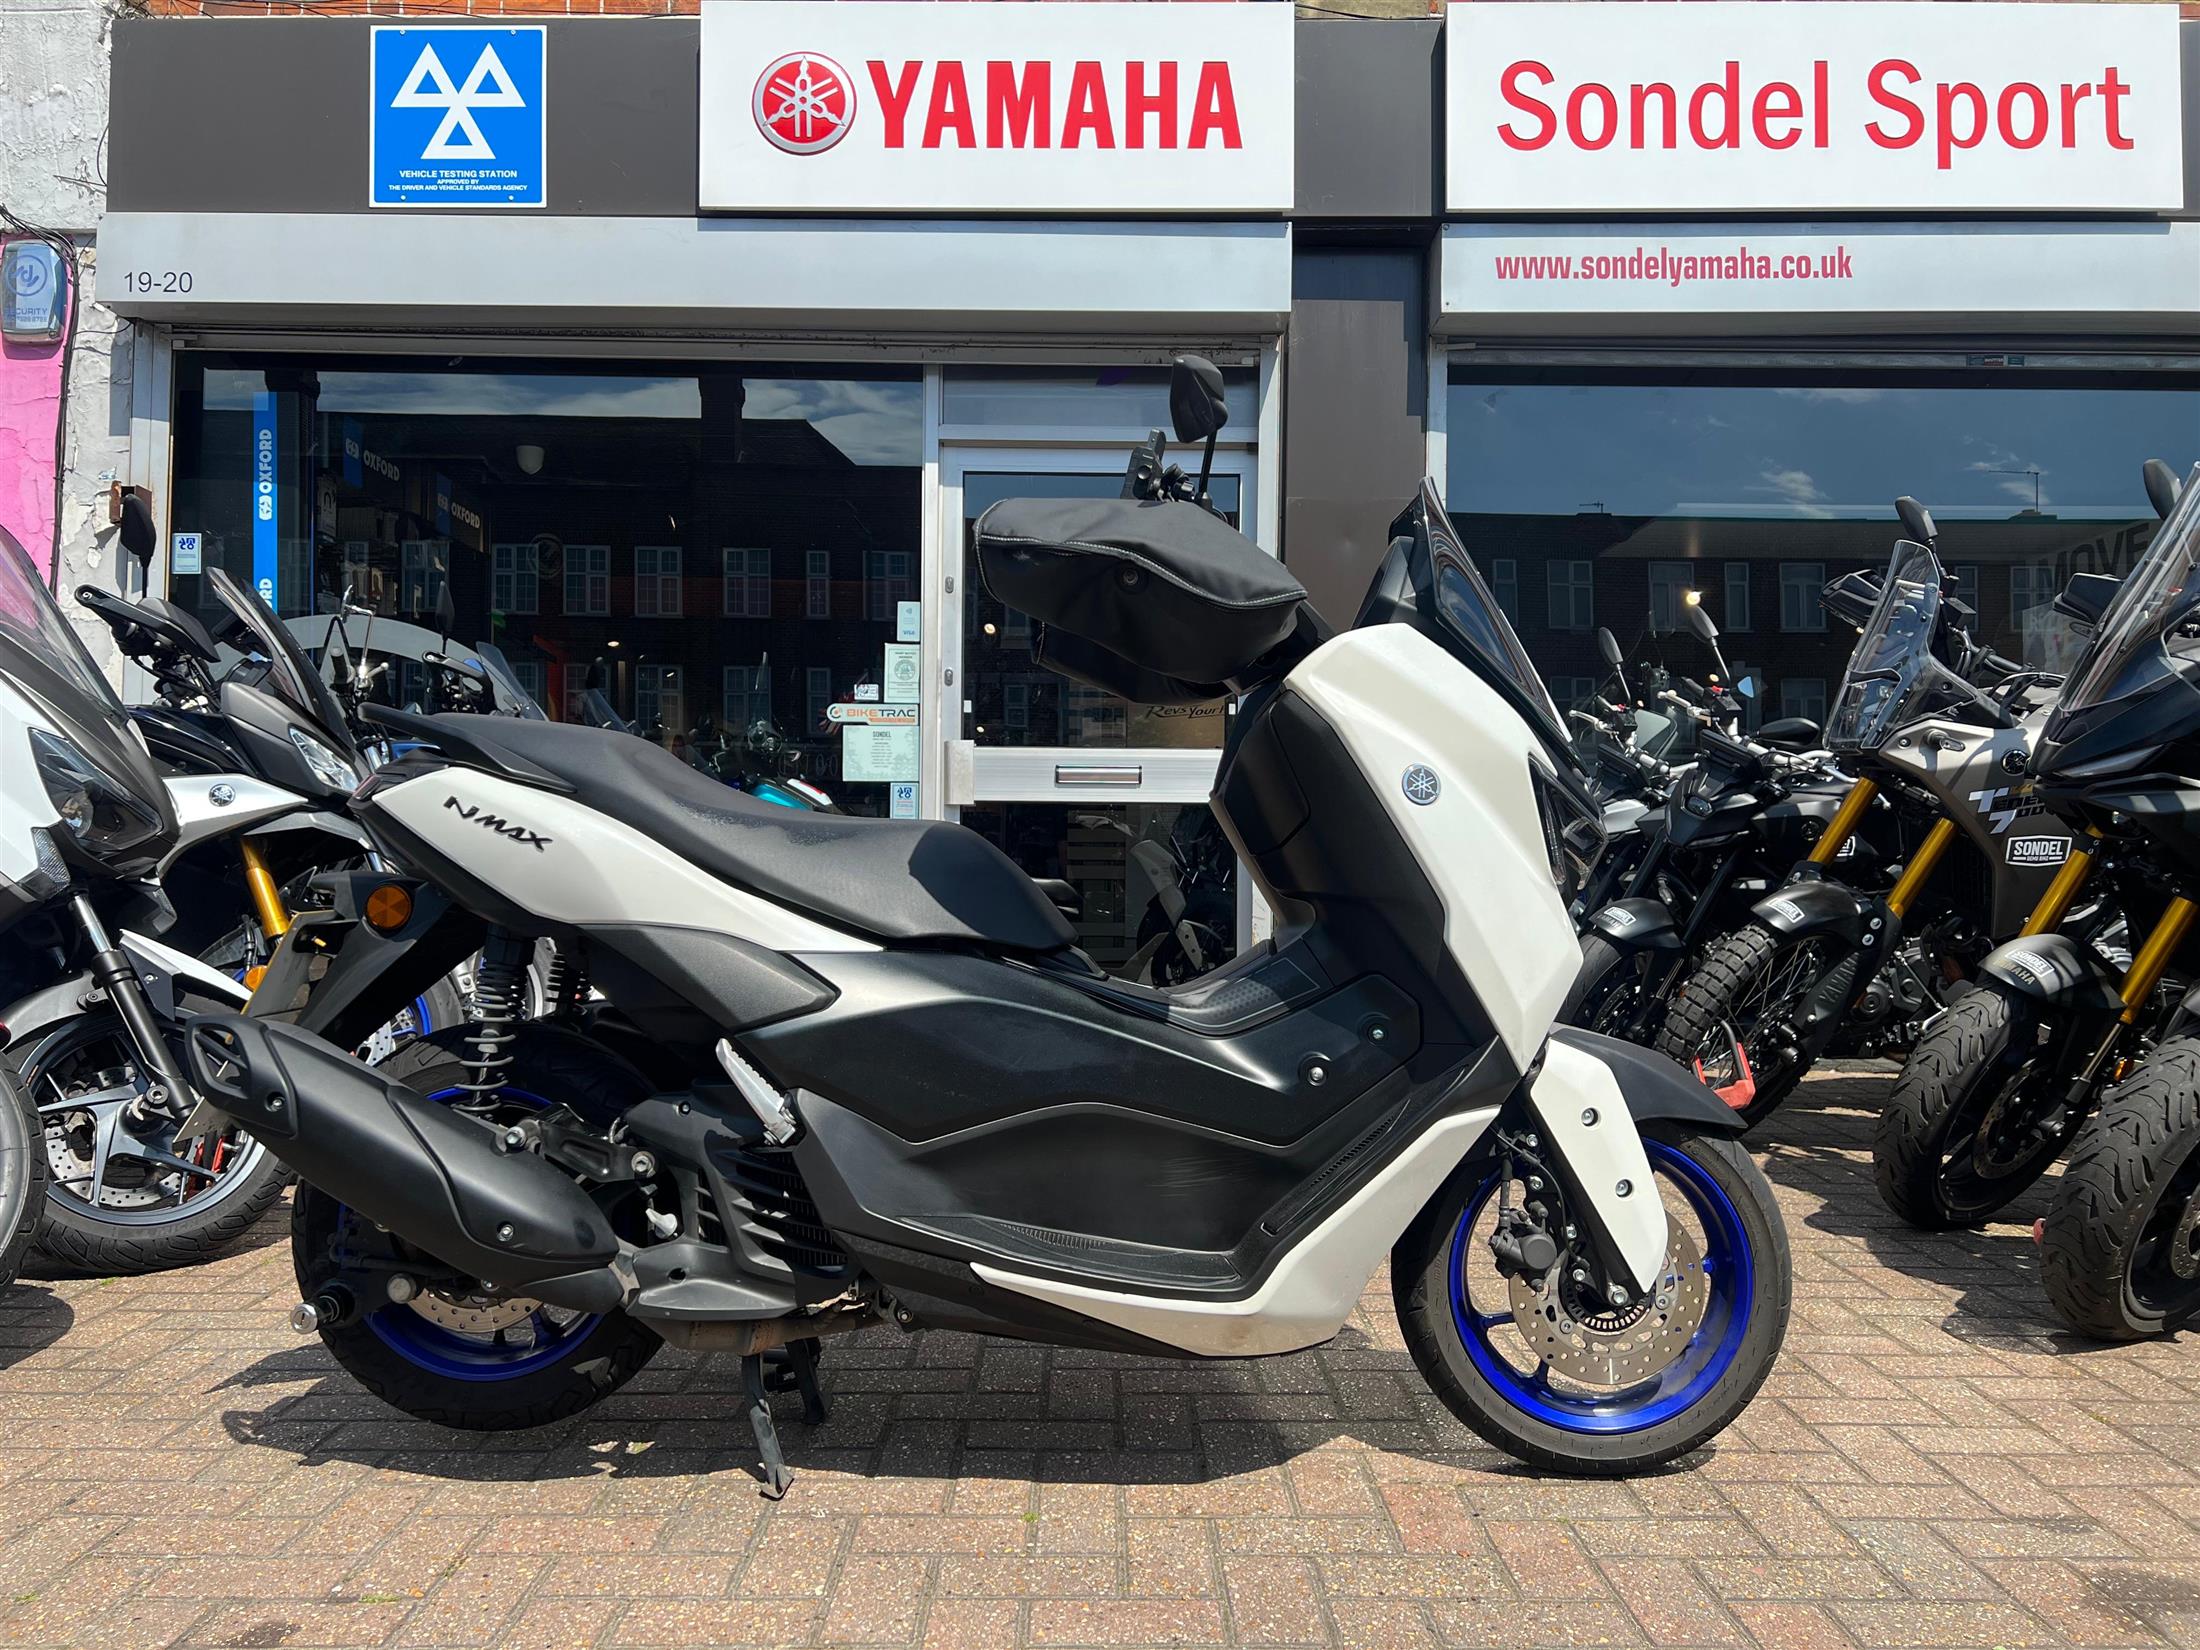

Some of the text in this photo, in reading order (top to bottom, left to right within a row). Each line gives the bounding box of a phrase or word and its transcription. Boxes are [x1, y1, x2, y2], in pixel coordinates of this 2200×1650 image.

[868, 61, 1242, 149] YAMAHA
[1497, 60, 2134, 170] Sondel Sport
[400, 170, 517, 178] VEHICLE TESTING STATION
[1496, 247, 1852, 287] www.sondelyamaha.co.uk
[124, 272, 193, 294] 19-20
[259, 429, 272, 493] OXFORD
[364, 451, 400, 482] OXFORD
[452, 503, 481, 529] OXFORD
[846, 708, 915, 717] BIKETRAC
[1144, 704, 1188, 719] Revs
[1188, 705, 1216, 719] Your
[443, 796, 553, 853] NMAX
[2014, 841, 2063, 855] SONDEL
[2014, 950, 2047, 972] SONDEL
